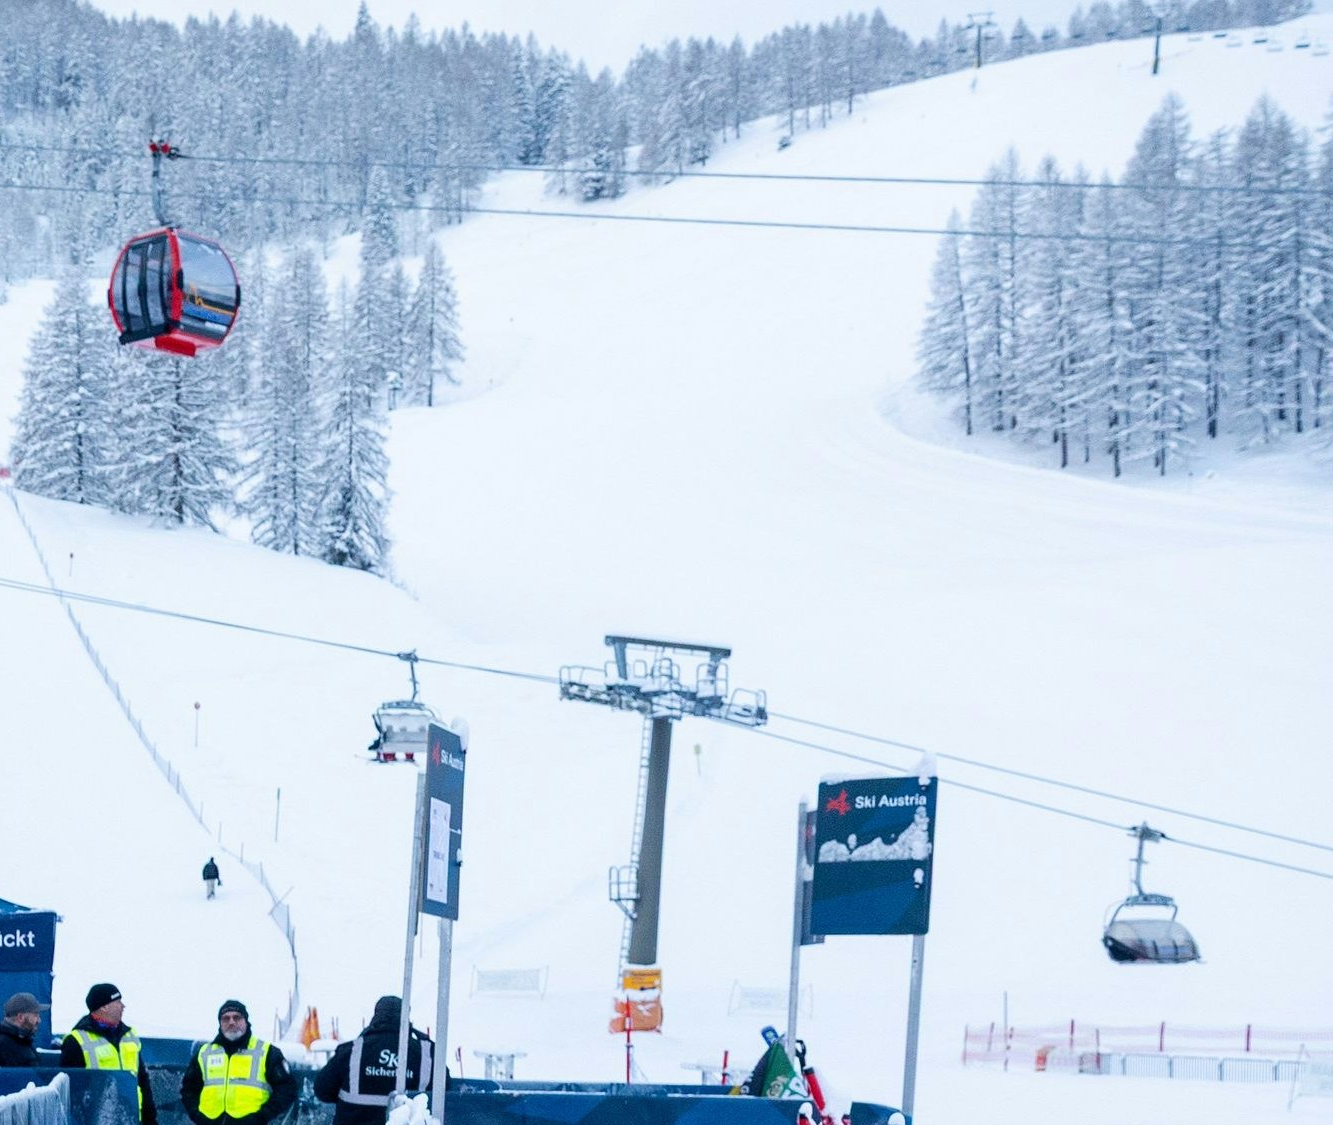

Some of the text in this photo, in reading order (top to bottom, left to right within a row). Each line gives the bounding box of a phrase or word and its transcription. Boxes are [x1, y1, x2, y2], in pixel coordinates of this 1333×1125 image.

[854, 793, 927, 809] Ski Austria
[365, 1066, 413, 1079] Sicherit
